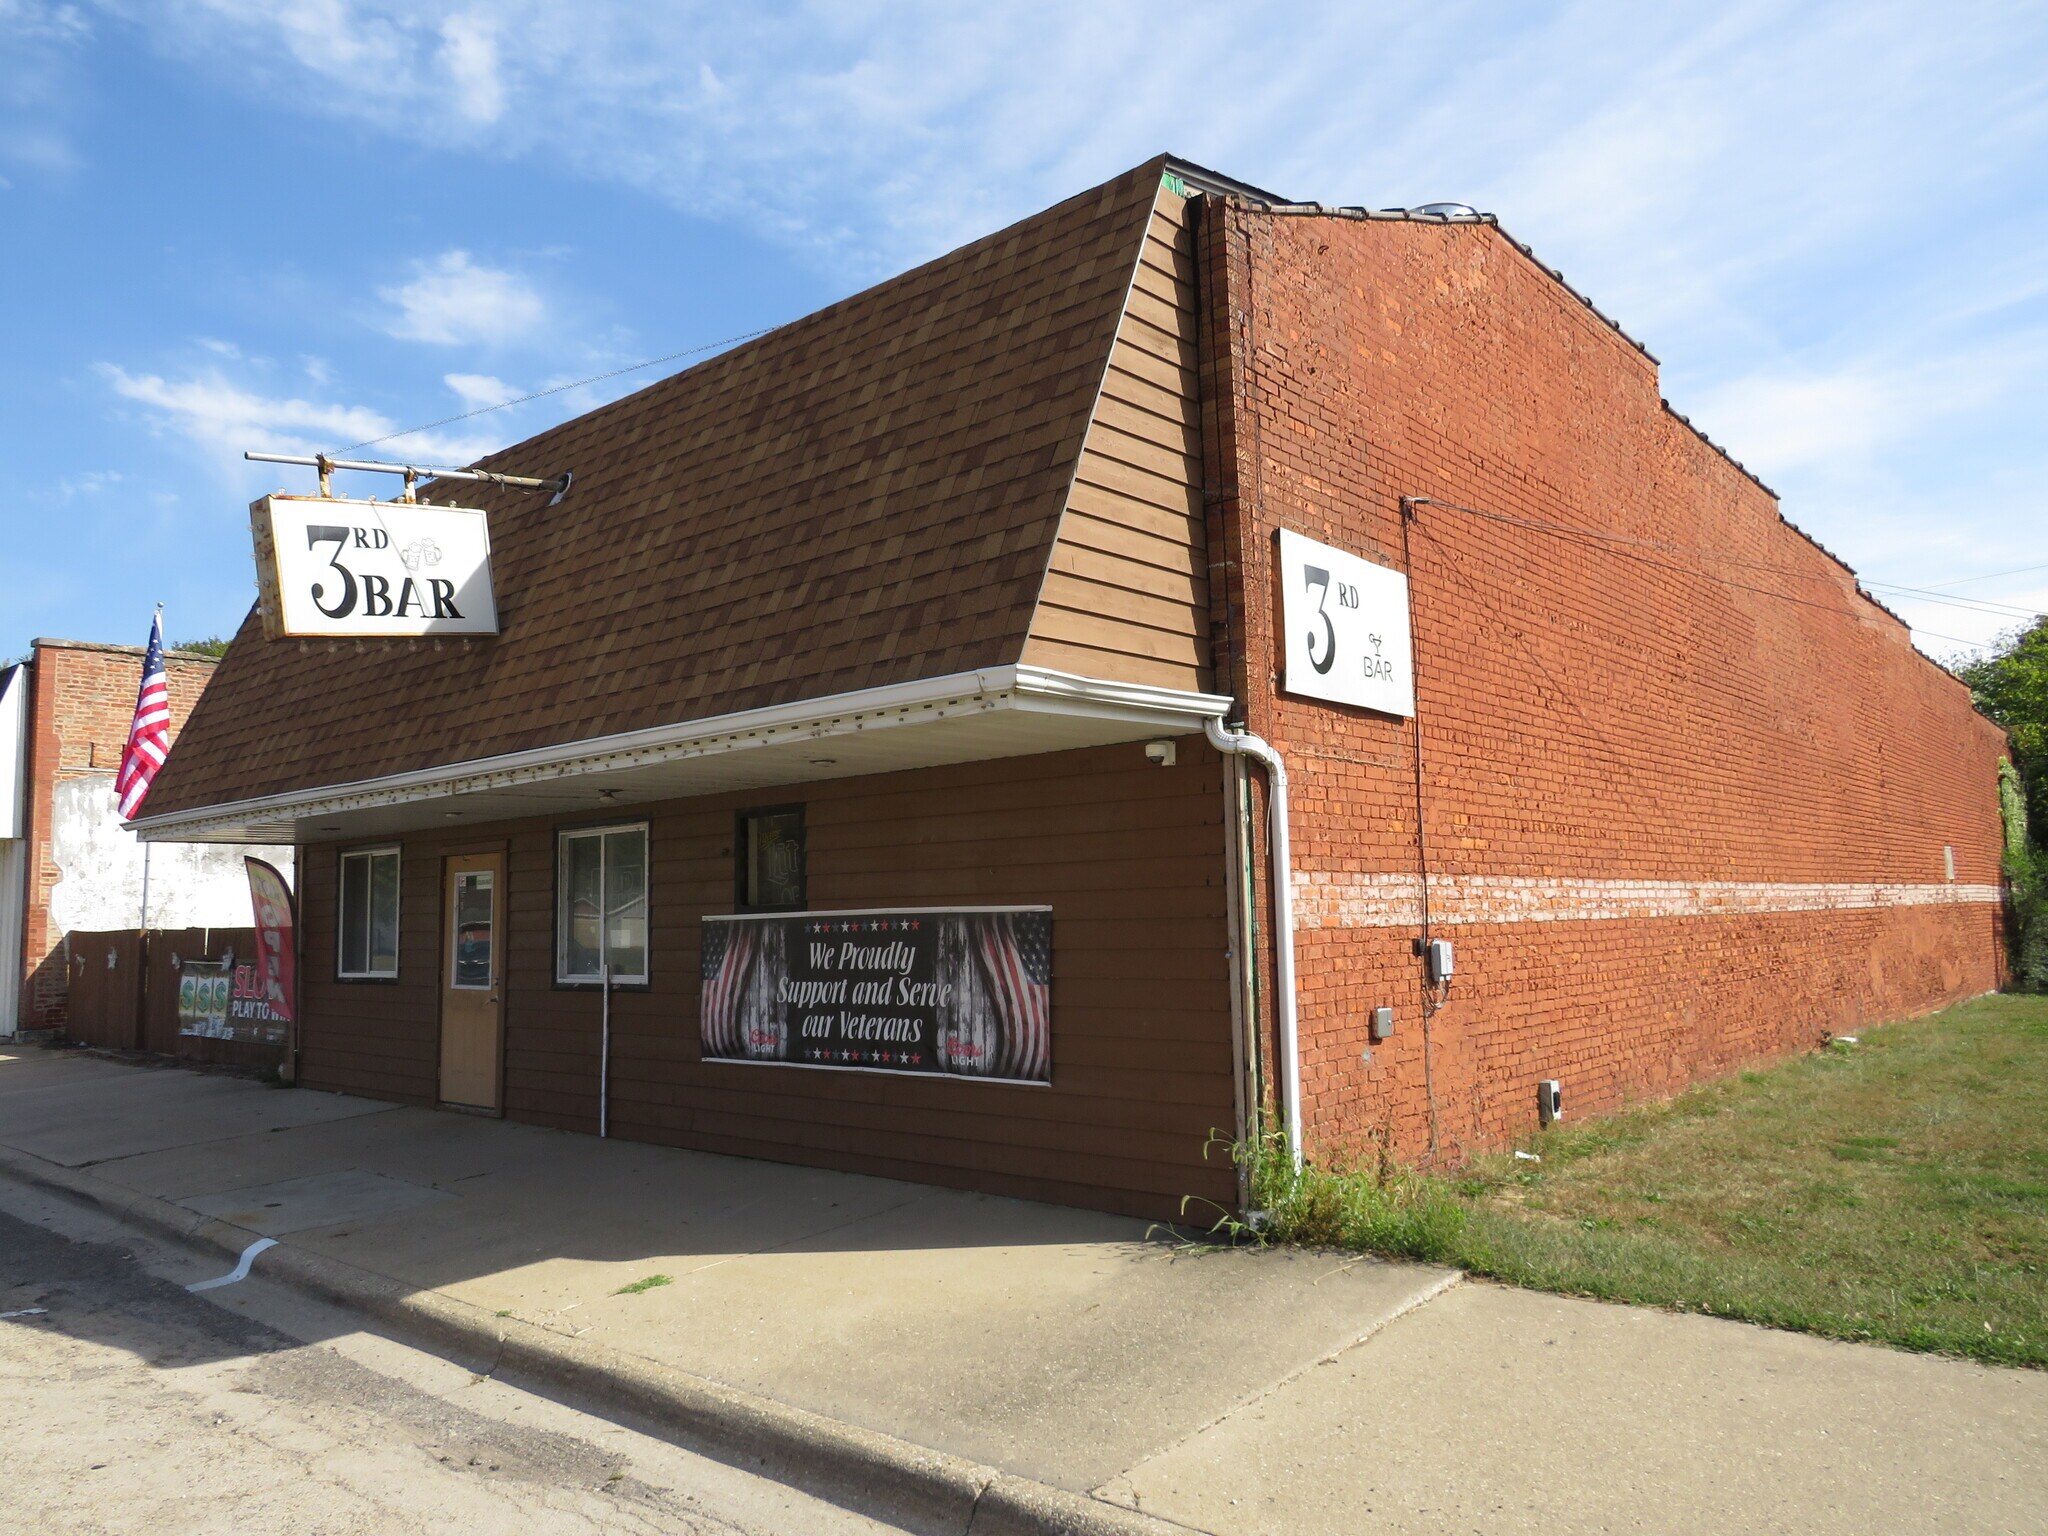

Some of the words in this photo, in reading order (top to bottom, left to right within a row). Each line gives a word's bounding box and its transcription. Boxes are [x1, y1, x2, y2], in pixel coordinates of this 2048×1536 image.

[359, 574, 465, 619] BAR
[1363, 656, 1393, 682] BAR
[809, 942, 834, 970] We
[838, 941, 916, 975] Proudly
[777, 976, 848, 1008] Support
[852, 977, 893, 1006] and
[896, 977, 952, 1008] Serve
[232, 1000, 256, 1018] PLAY
[256, 1002, 270, 1020] TO
[802, 1014, 834, 1038] our
[840, 1011, 923, 1042] Veterans
[754, 1044, 776, 1053] LIGHT
[948, 1036, 984, 1057] Coors
[951, 1055, 979, 1067] LIGHT
